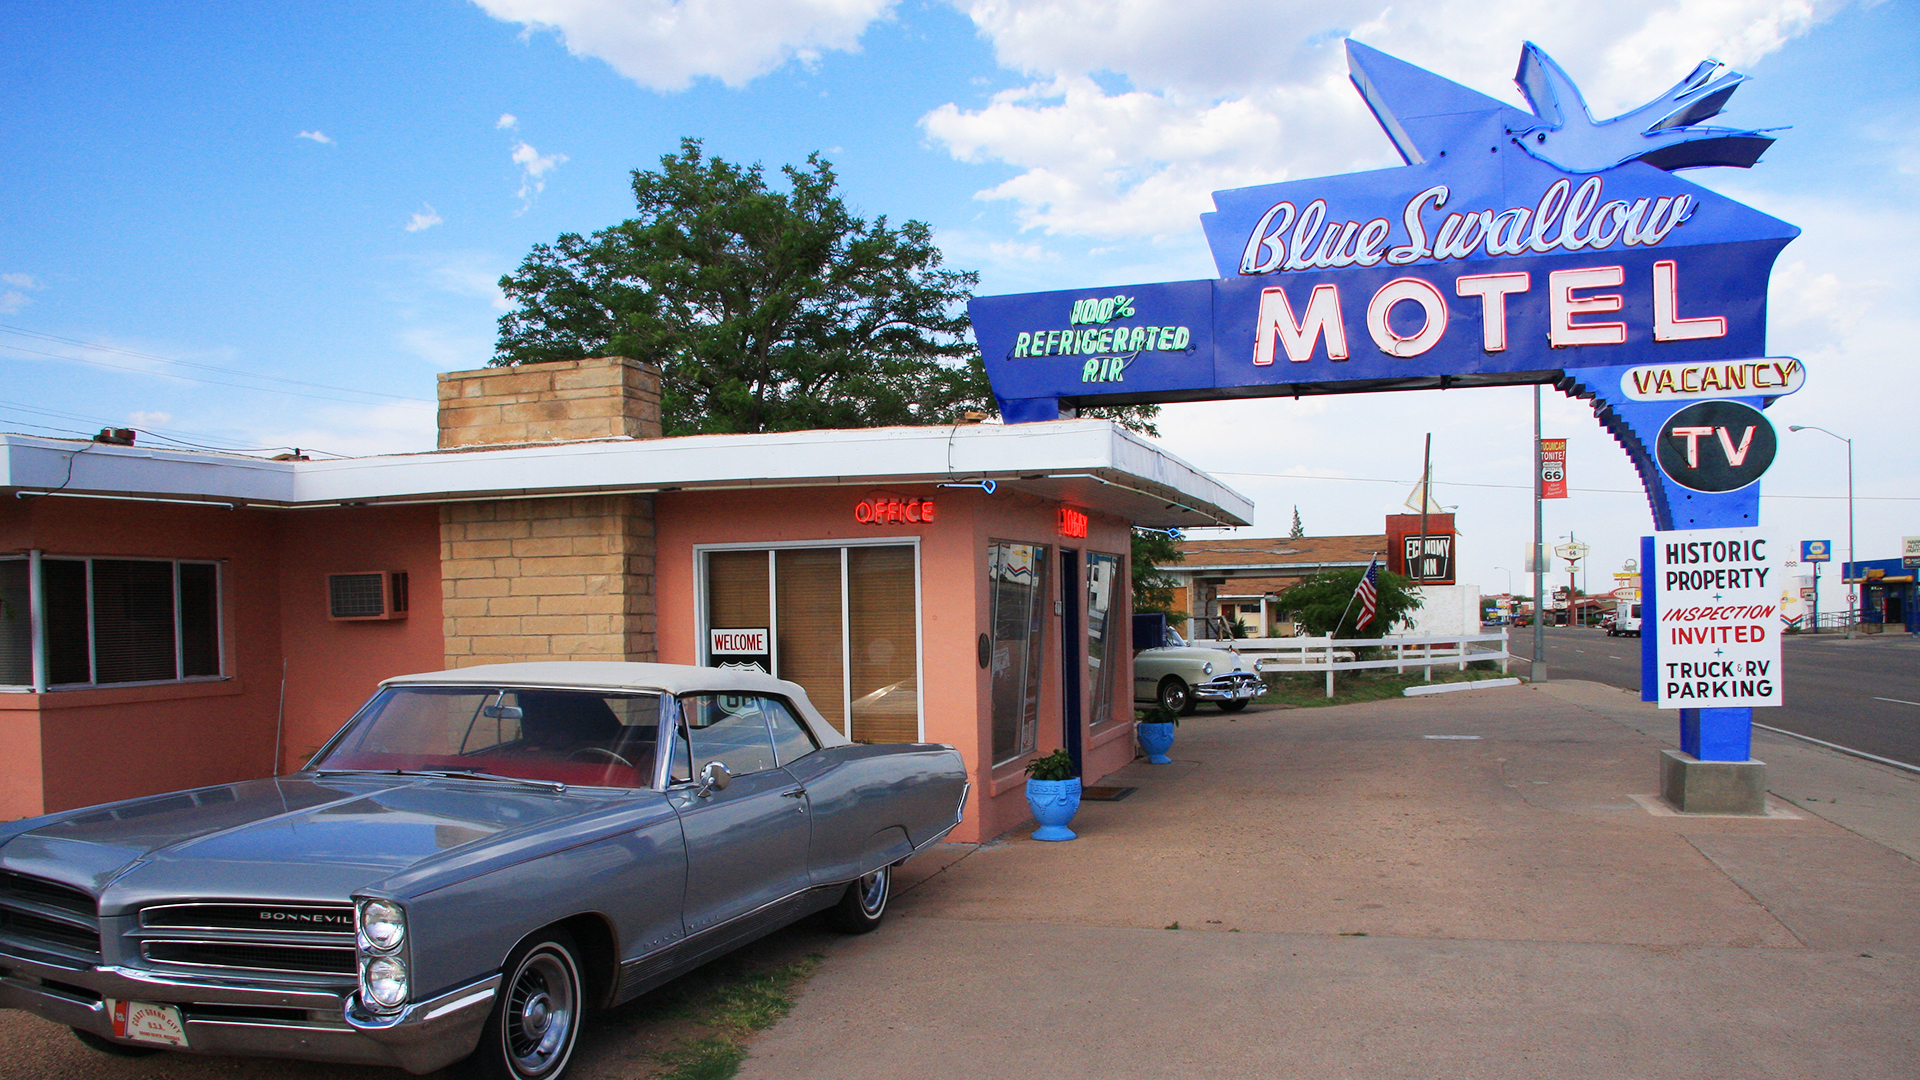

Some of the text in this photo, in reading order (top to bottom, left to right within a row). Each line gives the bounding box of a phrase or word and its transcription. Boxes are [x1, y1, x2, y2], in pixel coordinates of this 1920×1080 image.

[1239, 176, 1700, 276] Blue Swallow
[1071, 295, 1136, 325] 100%
[1252, 260, 1727, 367] MOTEL
[1014, 326, 1191, 358] REFRIGERATED
[1082, 357, 1124, 383] AIR
[1633, 359, 1797, 395] VACANCY
[1541, 451, 1566, 461] TONITE!
[1670, 425, 1758, 469] TV
[1544, 471, 1562, 480] 66
[855, 499, 935, 525] OFFICE
[1665, 539, 1767, 565] HISTORIC
[1421, 558, 1437, 576] NN
[1666, 567, 1770, 592] PROPERTY
[1662, 605, 1776, 622] INSPECTION
[714, 633, 763, 651] WELCOME
[1671, 625, 1766, 645] INVITED
[1666, 660, 1771, 679] TRUCK & RV
[1667, 680, 1773, 699] PARKING
[132, 1009, 182, 1033] COAST GUARD CITY
[148, 1022, 165, 1030] U.S.A.
